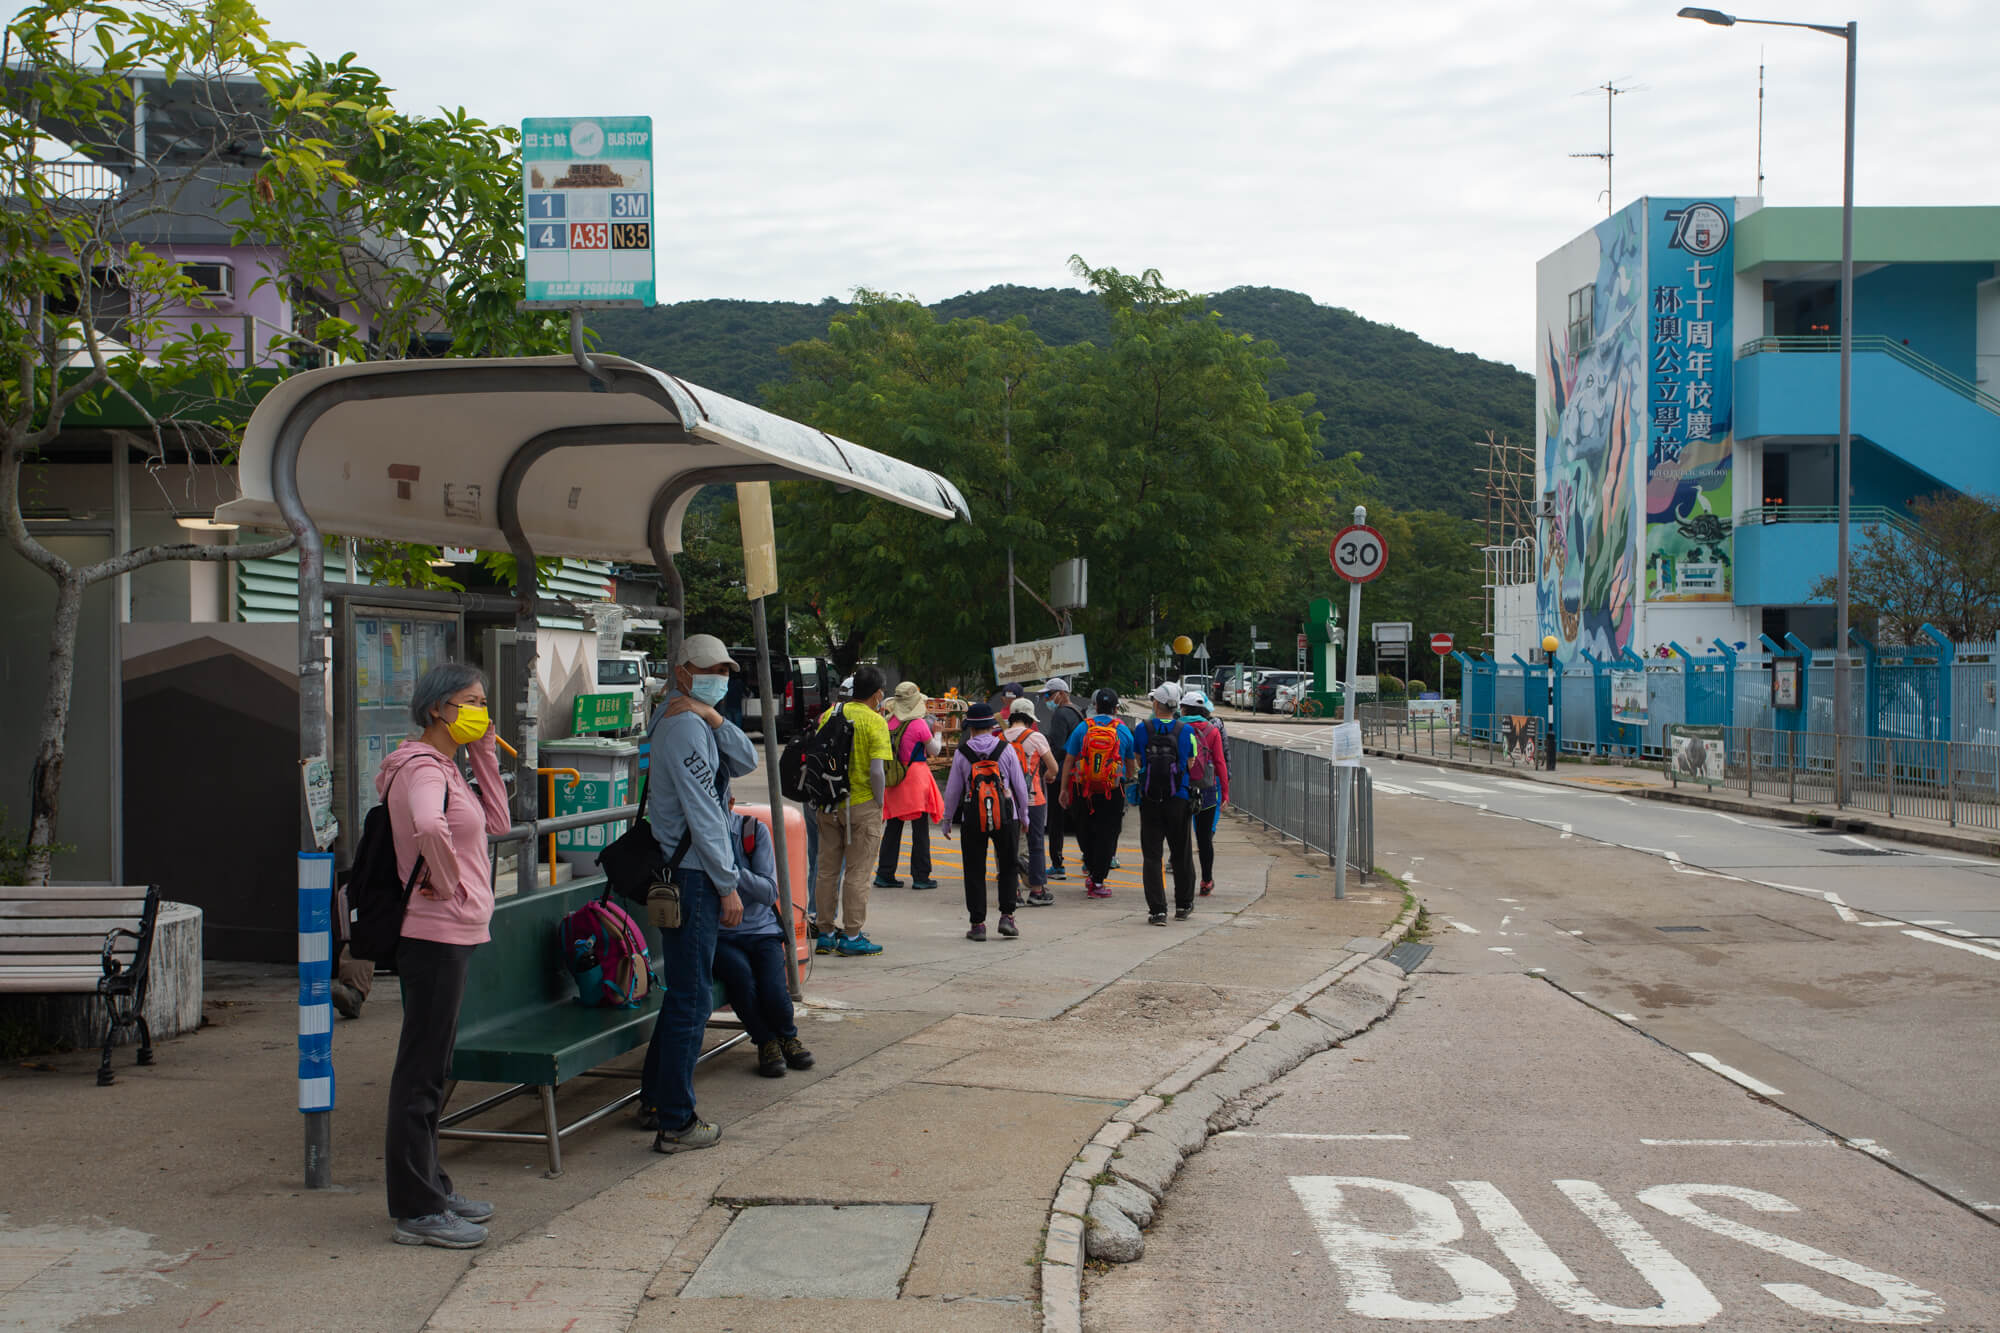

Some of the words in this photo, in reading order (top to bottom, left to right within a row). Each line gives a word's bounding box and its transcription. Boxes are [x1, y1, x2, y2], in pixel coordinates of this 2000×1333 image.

[525, 133, 567, 147] 巴士站
[608, 133, 625, 146] BUS
[626, 132, 648, 145] STOP
[542, 196, 552, 217] 1
[615, 195, 645, 216] 3M
[540, 226, 555, 247] 4
[572, 225, 607, 248] A35
[613, 224, 648, 248] N35
[1664, 202, 1729, 257] 70
[1685, 260, 1715, 440] 七十周年校慶
[1653, 285, 1683, 464] 杯澳公立學校
[1340, 542, 1379, 567] 30
[683, 751, 721, 807] OWER
[1288, 1175, 1947, 1328] BUS
